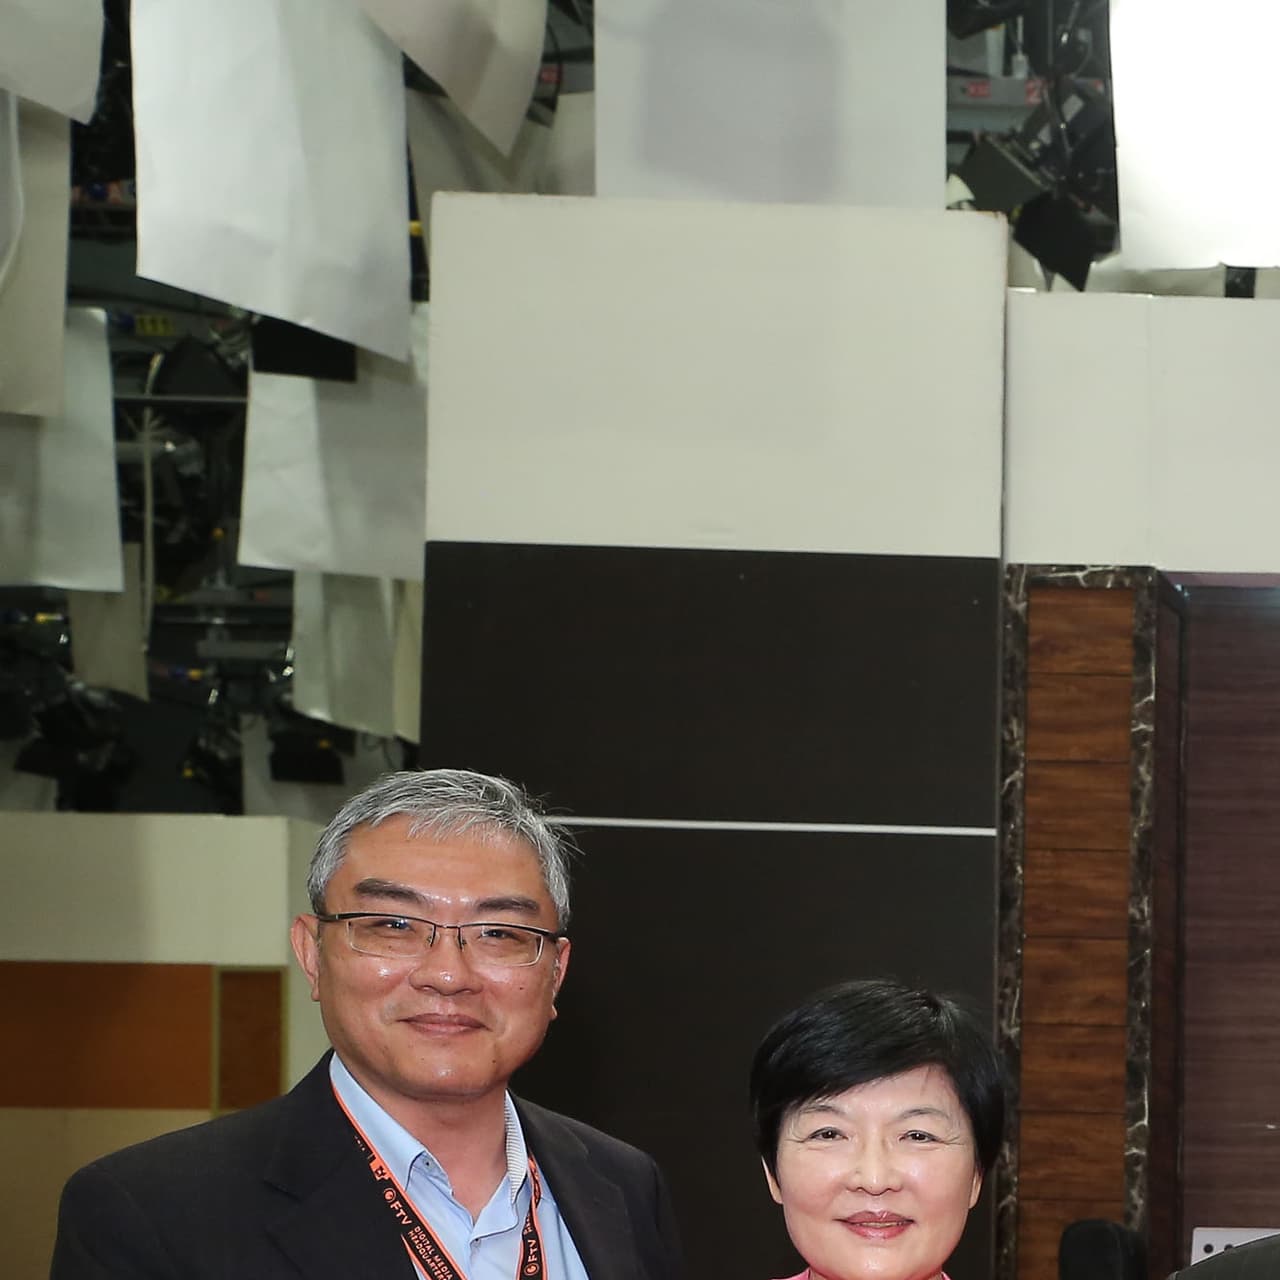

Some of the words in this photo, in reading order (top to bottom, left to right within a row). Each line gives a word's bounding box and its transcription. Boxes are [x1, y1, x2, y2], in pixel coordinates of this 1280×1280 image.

[390, 1201, 413, 1226] FTV
[414, 1226, 434, 1255] DIGITAL
[434, 1254, 454, 1280] MEDIA
[527, 1239, 539, 1263] FTV
